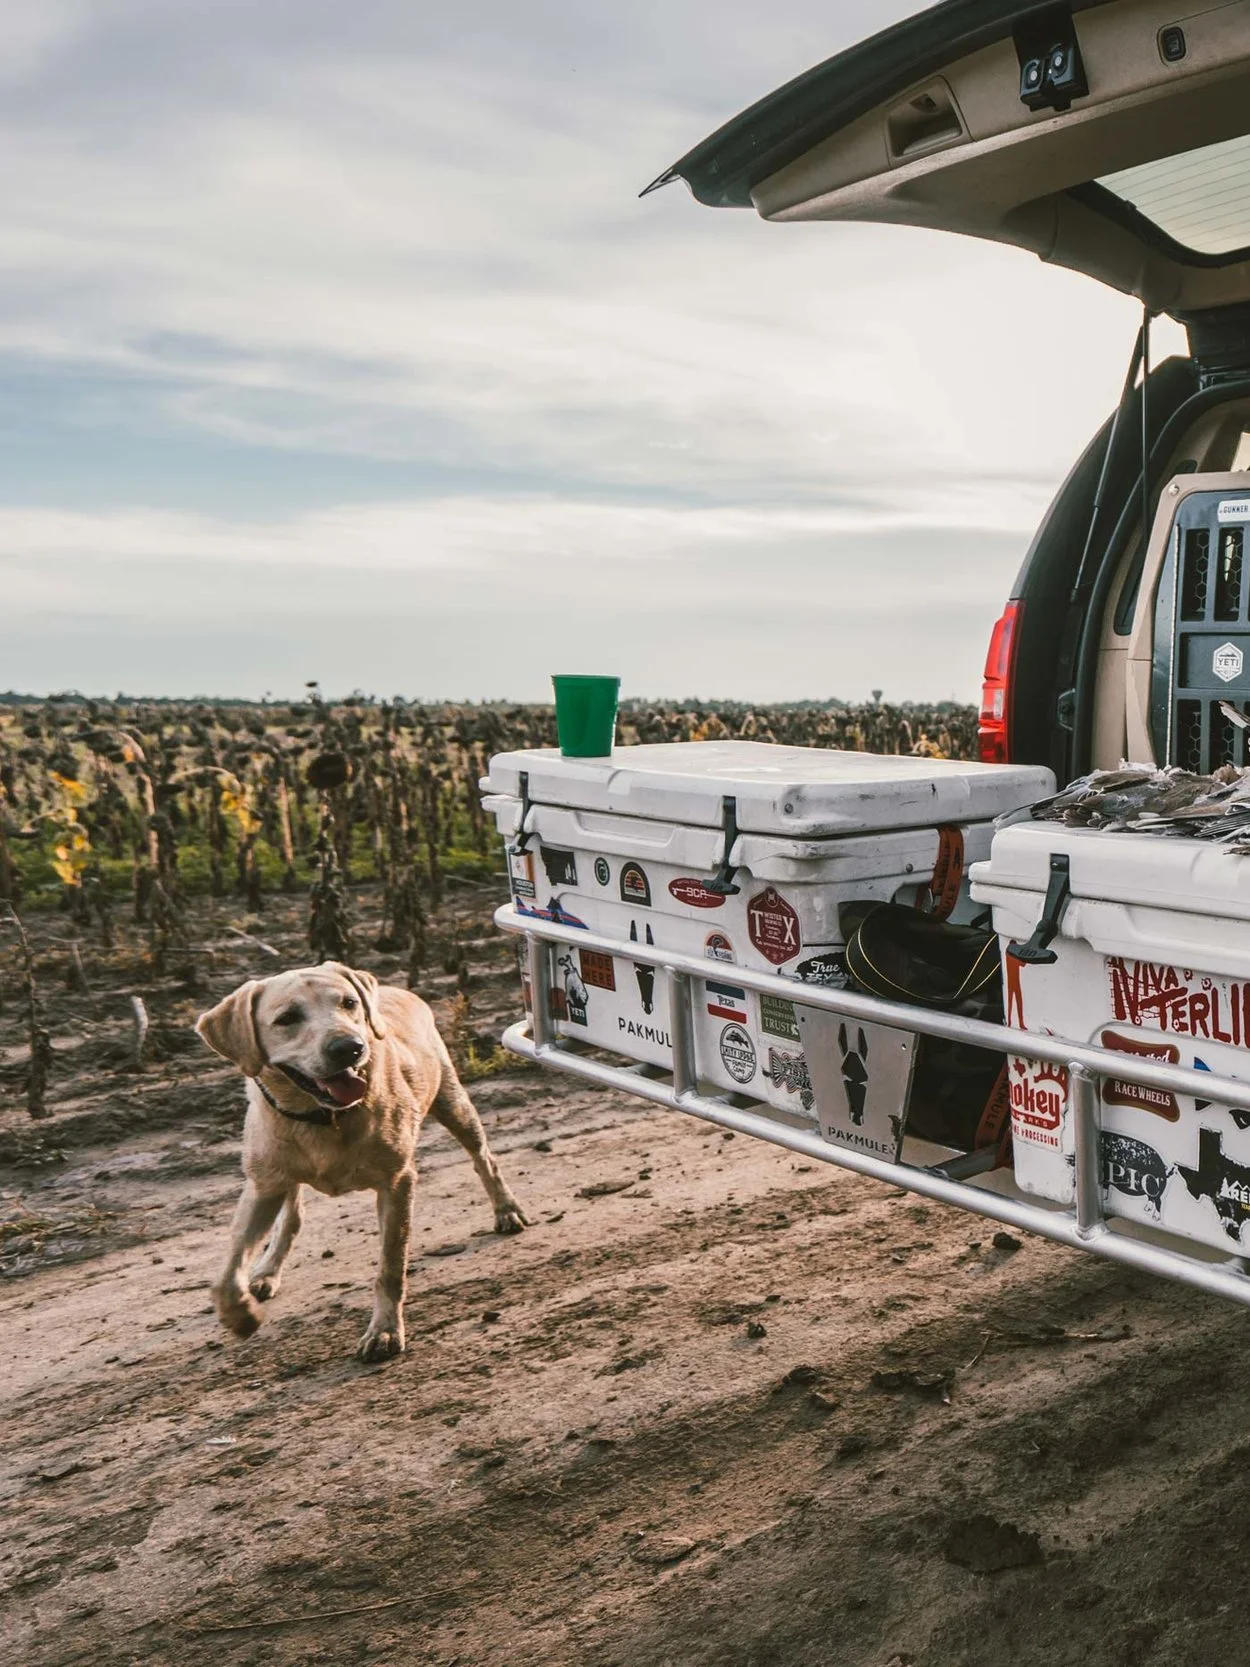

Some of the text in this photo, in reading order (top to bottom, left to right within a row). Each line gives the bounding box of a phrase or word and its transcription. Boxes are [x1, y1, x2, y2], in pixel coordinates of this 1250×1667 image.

[1223, 505, 1248, 514] GUNNER
[1218, 658, 1239, 667] YETI
[582, 953, 612, 972] MADE
[811, 961, 840, 973] True
[584, 968, 613, 987] HERE
[717, 995, 735, 1008] Texas
[763, 995, 794, 1011] BUILDIN
[571, 1007, 585, 1018] YETI
[618, 1016, 673, 1048] PAKMUL
[764, 1016, 791, 1033] TRUST
[1114, 1080, 1171, 1107] RACE WHEELS
[829, 1126, 891, 1156] PAKMULE
[1021, 1128, 1059, 1147] PROCESSING
[1107, 1161, 1161, 1198] PIC
